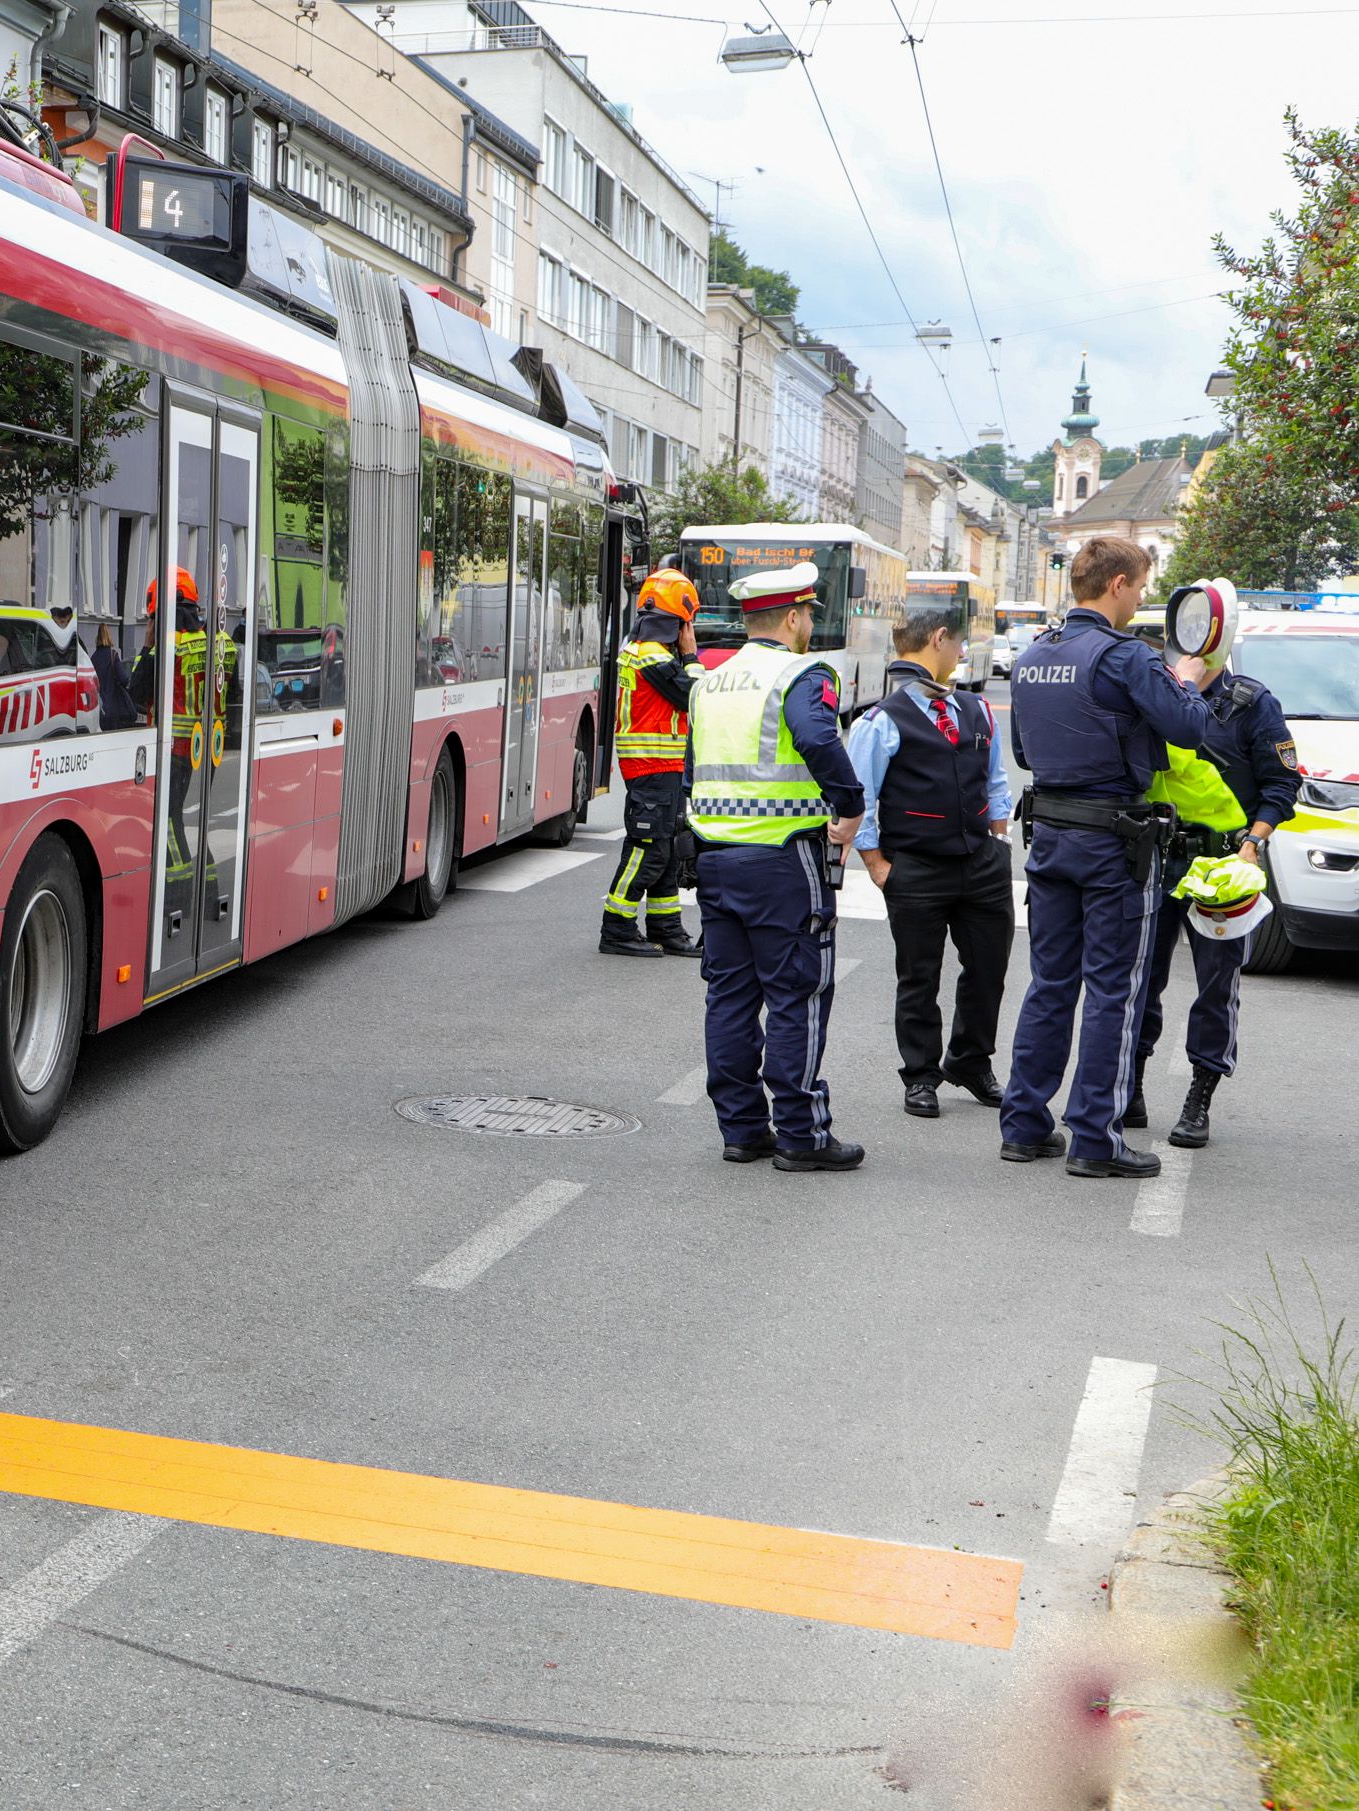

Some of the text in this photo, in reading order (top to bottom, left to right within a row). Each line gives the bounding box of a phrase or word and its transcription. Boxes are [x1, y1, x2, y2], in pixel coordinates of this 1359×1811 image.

[164, 190, 184, 227] 4
[700, 547, 724, 565] 150
[737, 547, 760, 556] Bad
[765, 547, 795, 557] Ischl
[1017, 665, 1076, 684] POLIZEI
[44, 753, 88, 776] SALZBURG
